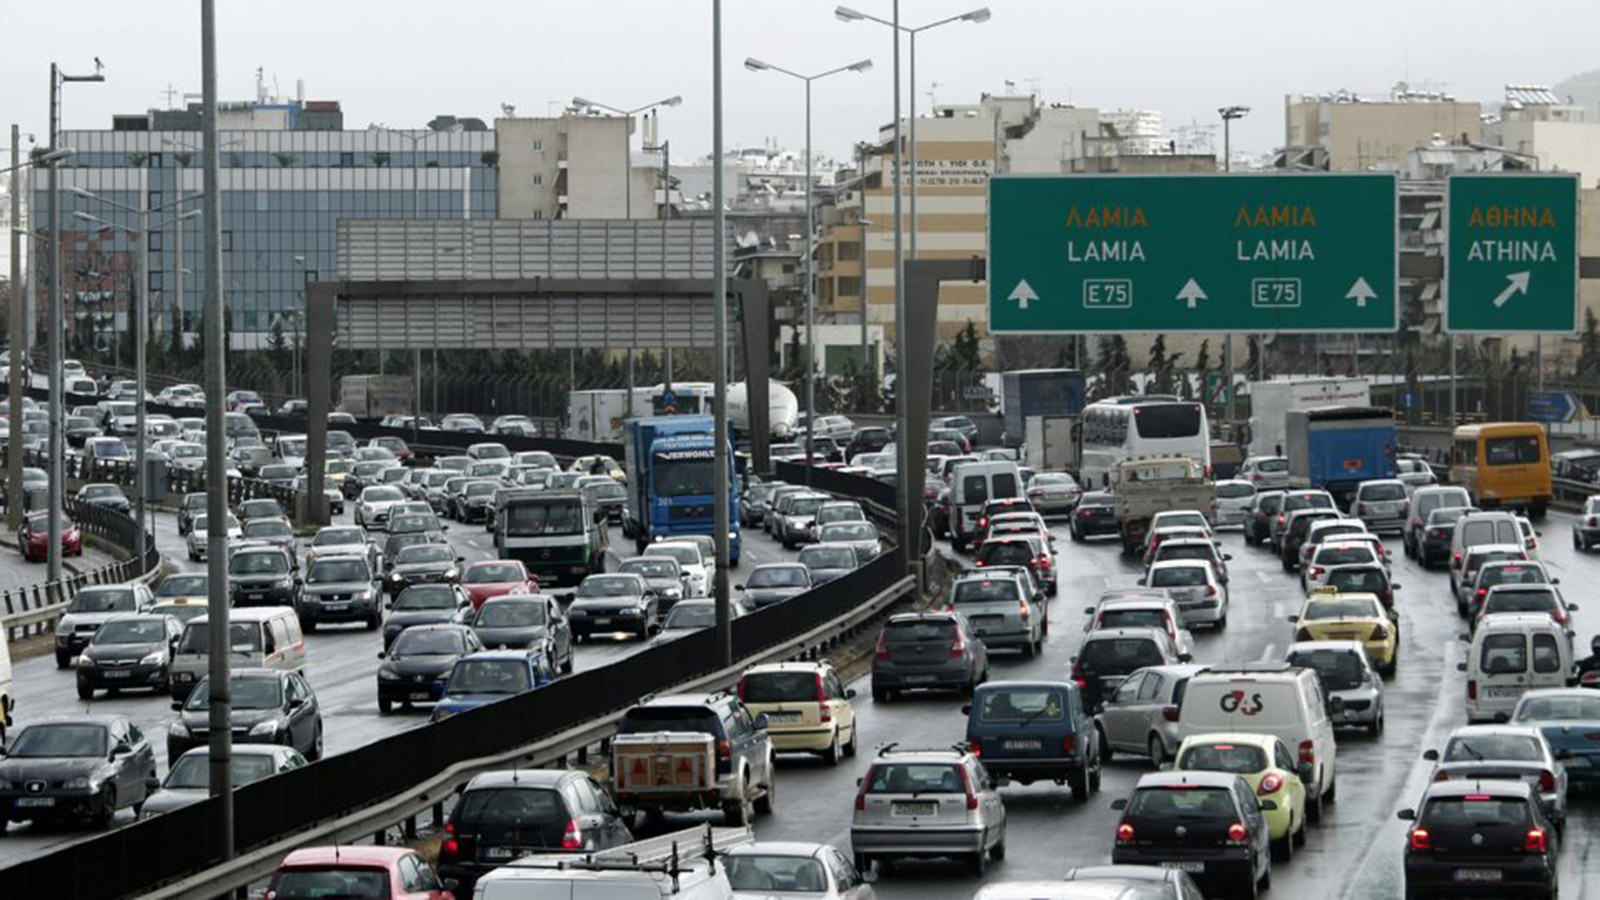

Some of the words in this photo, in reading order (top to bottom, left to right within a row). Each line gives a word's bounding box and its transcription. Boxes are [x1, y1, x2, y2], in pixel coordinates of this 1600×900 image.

[1066, 206, 1147, 228] ΛΑΜΙΑ
[1235, 205, 1316, 227] ΛΑΜΙΑ
[1469, 206, 1556, 228] ΑΘΗΝΑ
[1067, 242, 1145, 262] LAMIA
[1237, 240, 1315, 261] LAMIA
[1467, 241, 1557, 262] ATHINA
[1219, 689, 1264, 716] G4S
